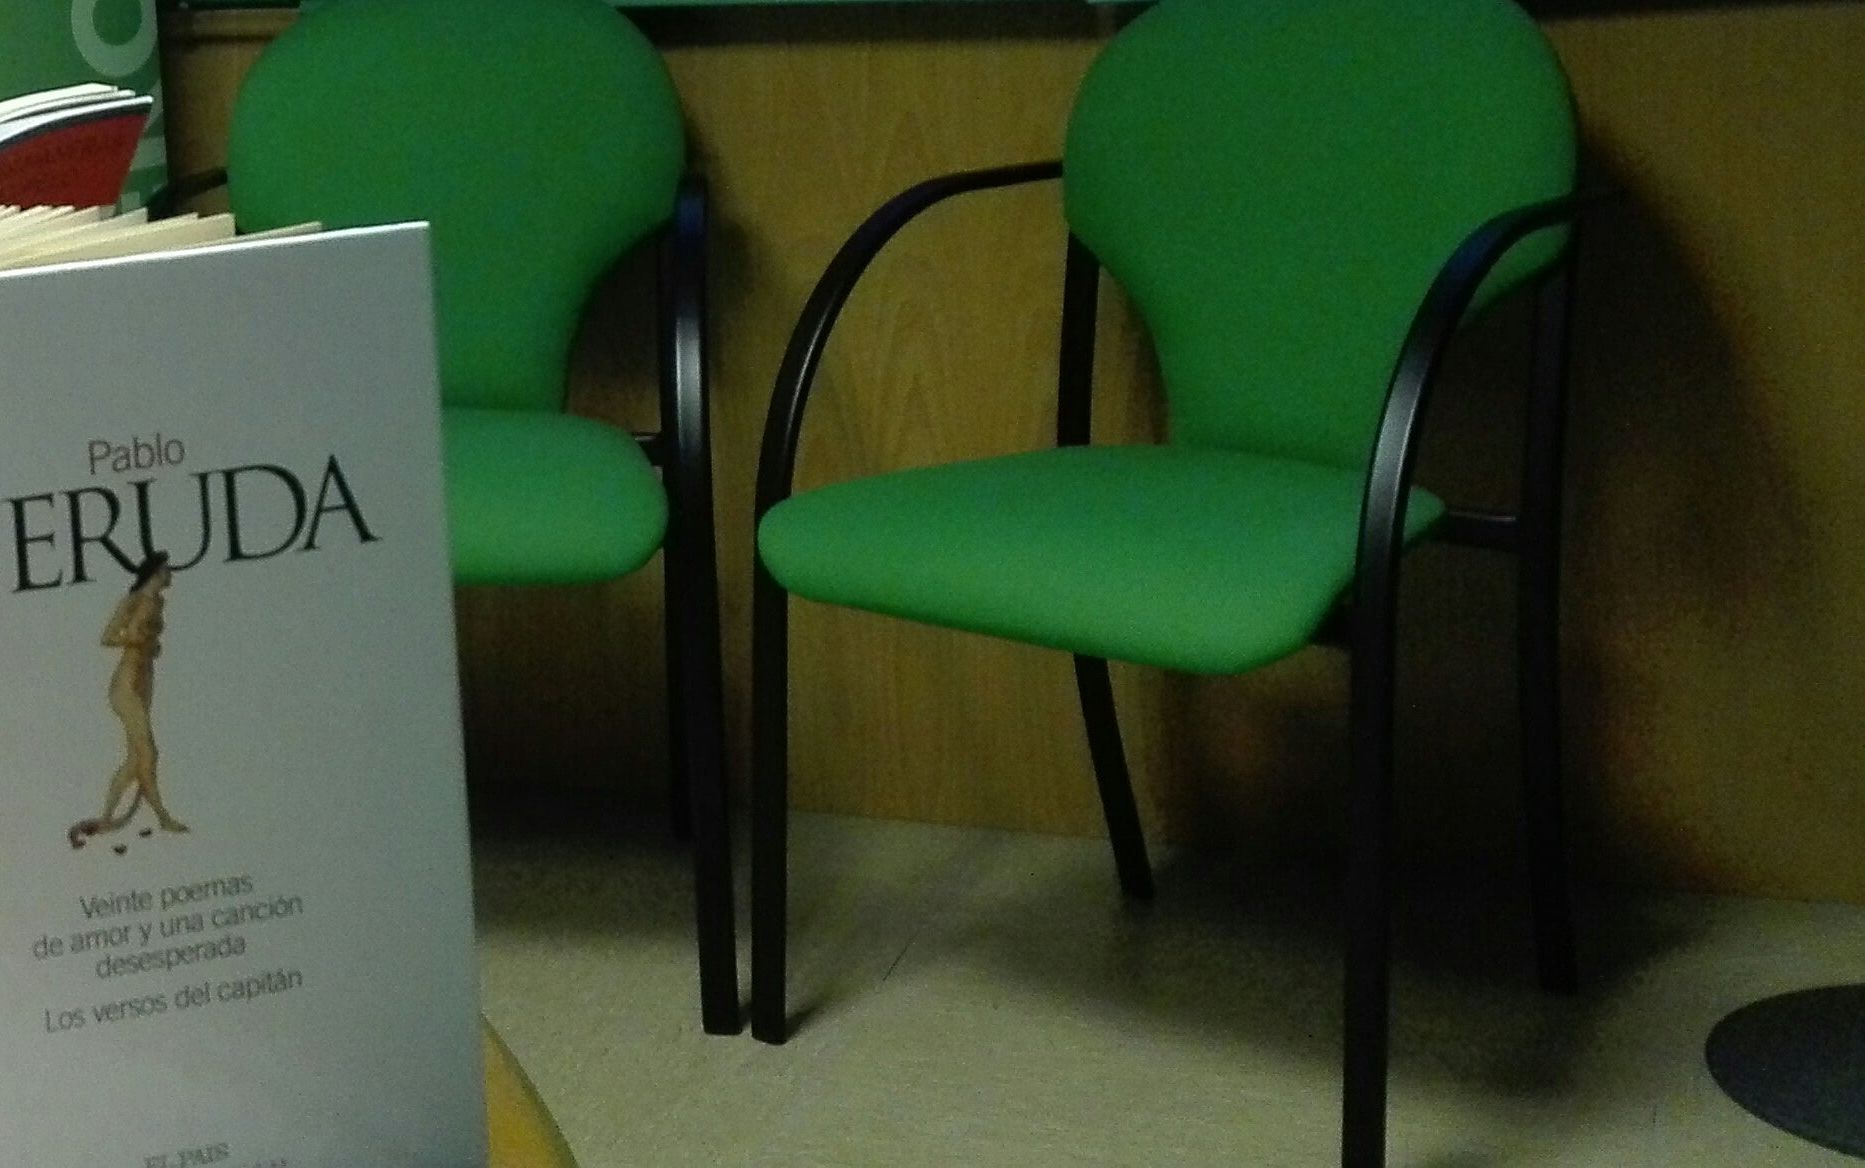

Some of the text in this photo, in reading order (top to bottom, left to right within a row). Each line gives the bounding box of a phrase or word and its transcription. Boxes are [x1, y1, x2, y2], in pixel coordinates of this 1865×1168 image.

[87, 432, 185, 474] Pablo
[79, 874, 253, 919] Veinte poemas
[32, 894, 304, 960] de amor y una canción
[95, 934, 246, 979] desesperada
[44, 968, 303, 1034] Los versos del capitán
